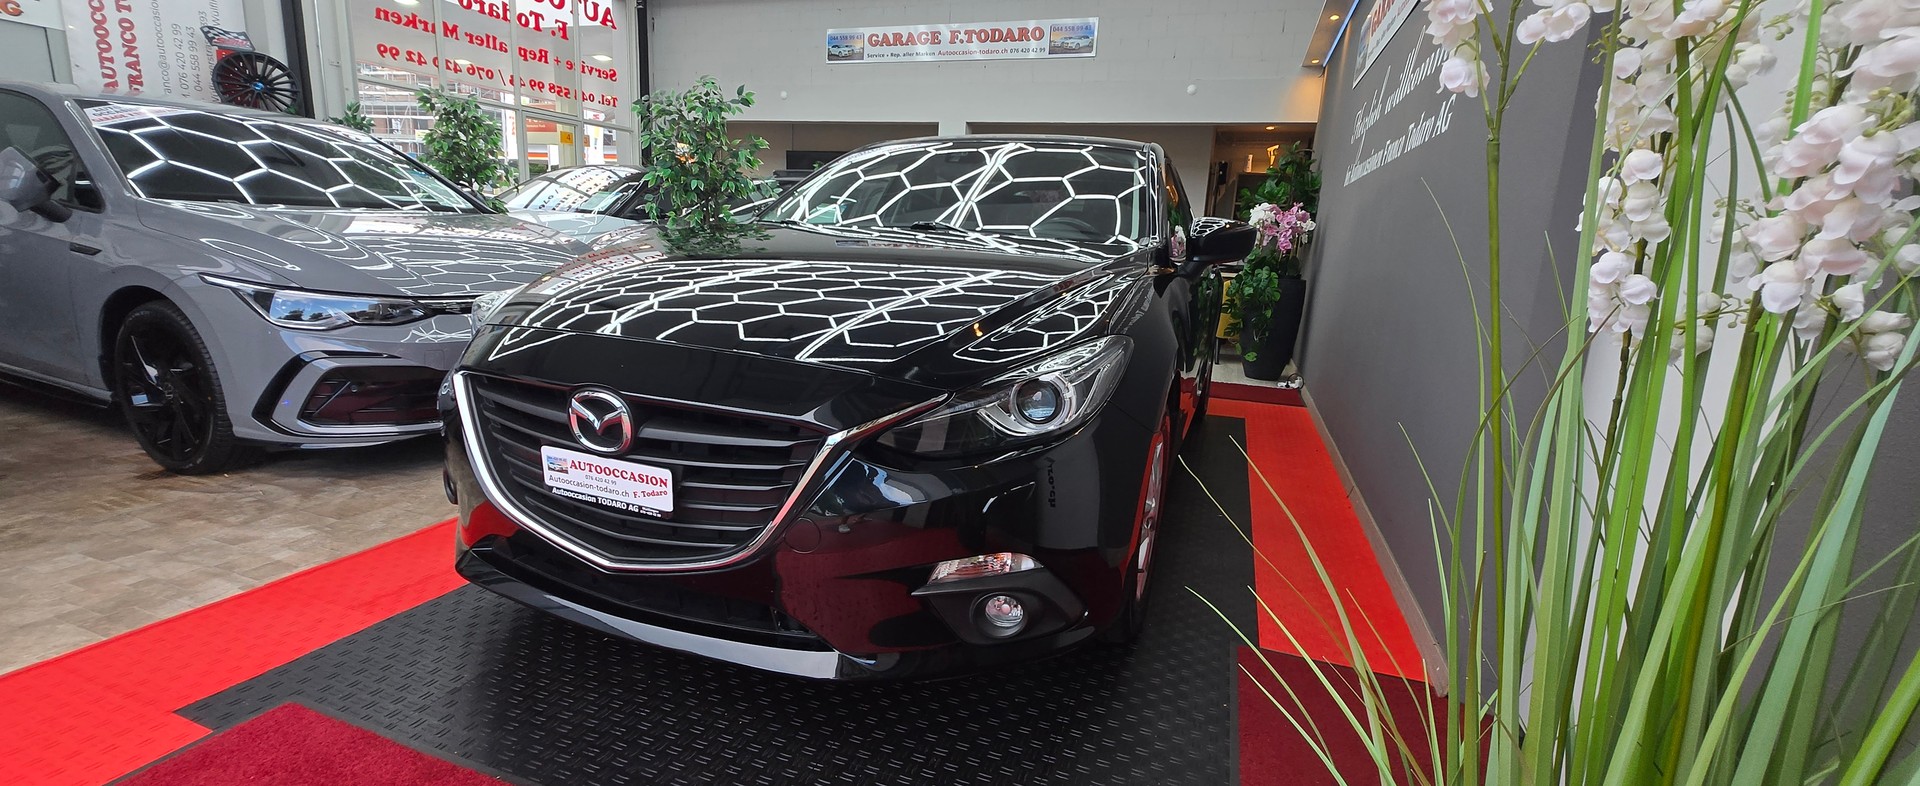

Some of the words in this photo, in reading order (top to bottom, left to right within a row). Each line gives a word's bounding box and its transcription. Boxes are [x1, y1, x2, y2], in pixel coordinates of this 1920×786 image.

[171, 23, 182, 36] 99
[185, 26, 196, 38] 43
[867, 30, 942, 47] GARAGE
[949, 26, 1045, 45] F.TODARO
[173, 38, 184, 50] 42
[187, 40, 199, 53] 99
[938, 48, 1008, 56] Autooccasion-todaro.ch
[175, 52, 187, 70] 420
[188, 55, 201, 71] 558
[177, 72, 190, 90] 076
[191, 73, 203, 92] 044
[1432, 93, 1457, 139] AG
[569, 459, 668, 488] AUTOOCCASION
[549, 474, 630, 498] Autooccasion-todaro.ch
[641, 489, 668, 498] Todaro
[552, 487, 596, 503] Autooccasion
[597, 496, 627, 510] TODARO
[628, 503, 639, 513] AG
